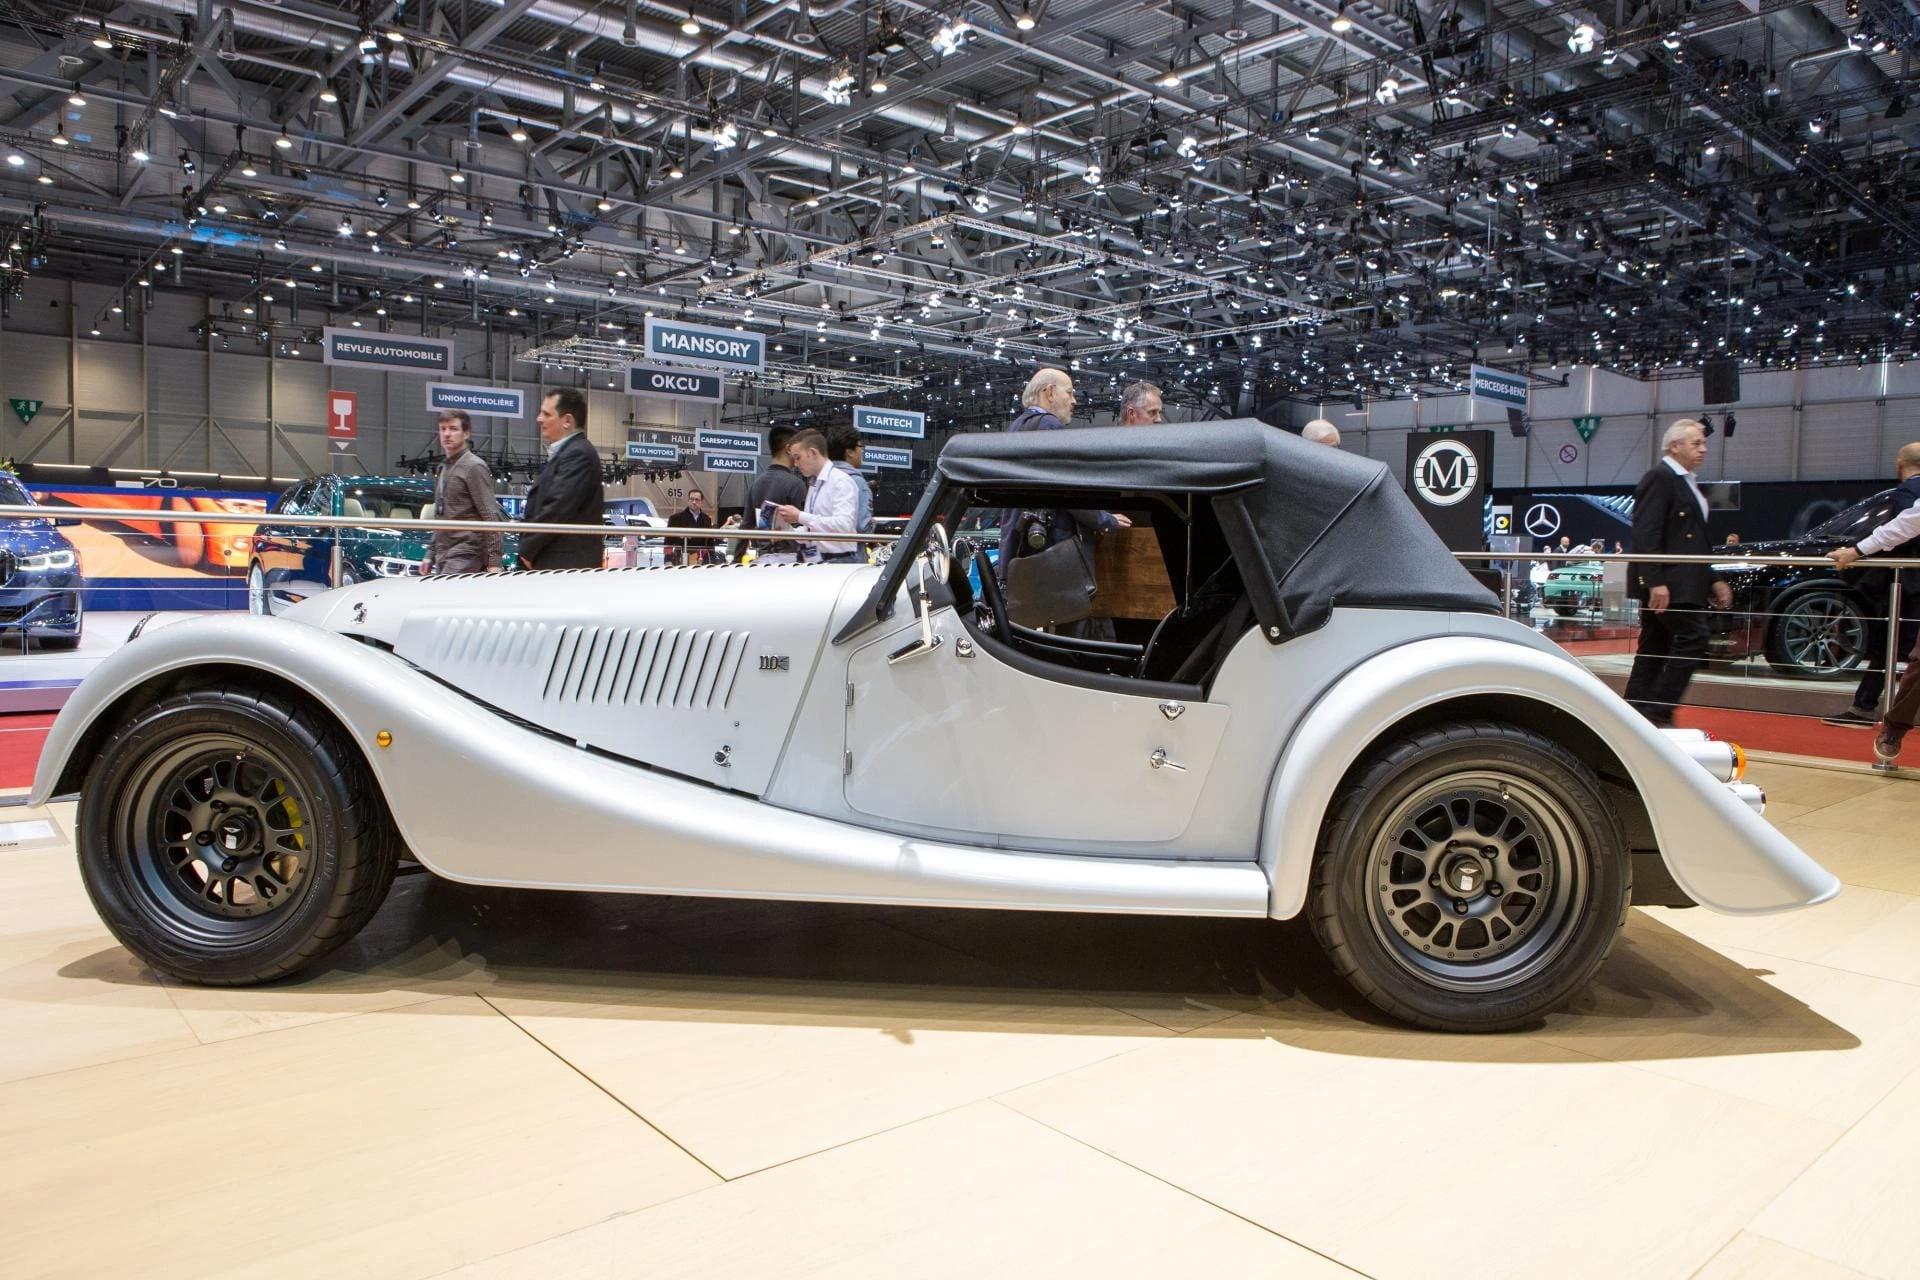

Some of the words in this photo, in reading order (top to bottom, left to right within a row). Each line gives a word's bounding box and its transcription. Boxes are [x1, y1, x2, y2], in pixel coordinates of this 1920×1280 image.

[661, 332, 751, 358] MANSORY
[336, 343, 372, 355] REVUE
[373, 346, 443, 361] AUTOMOBILE
[651, 374, 700, 392] OKCU
[1475, 378, 1526, 397] MERCEDES-BENZ
[438, 394, 466, 403] UNION
[467, 395, 514, 407] PÉTROLIÈRE
[866, 415, 913, 428] STARTECH
[700, 437, 732, 445] CARESOFT
[647, 448, 674, 456] MOTORS
[865, 452, 908, 462] SHARE2DRIVE
[713, 459, 749, 468] ARAMCO
[668, 488, 682, 497] 615
